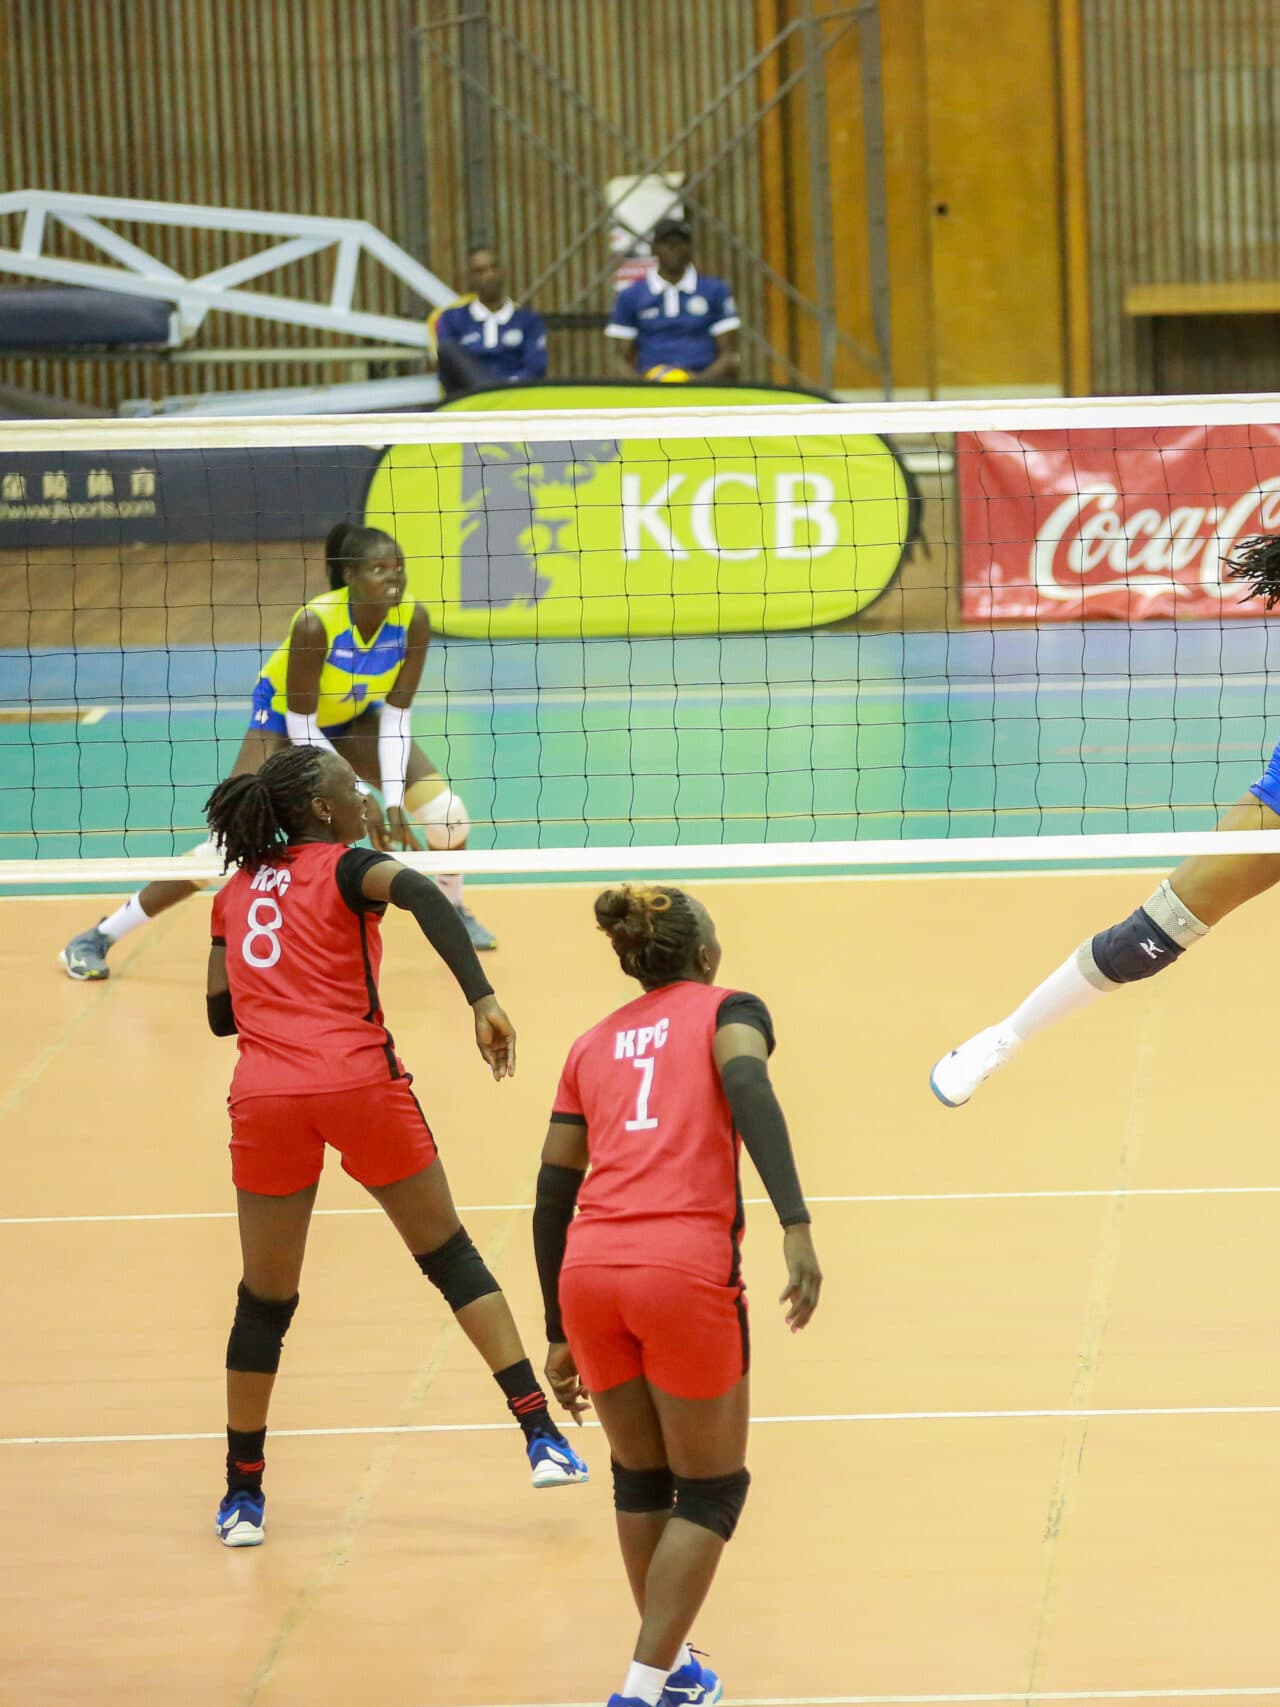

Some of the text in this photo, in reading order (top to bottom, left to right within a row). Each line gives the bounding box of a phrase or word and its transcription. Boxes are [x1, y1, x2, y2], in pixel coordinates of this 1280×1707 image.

[621, 472, 839, 561] KCB
[242, 898, 283, 968] 8
[614, 1017, 669, 1060] KPC
[625, 1056, 659, 1132] 1
